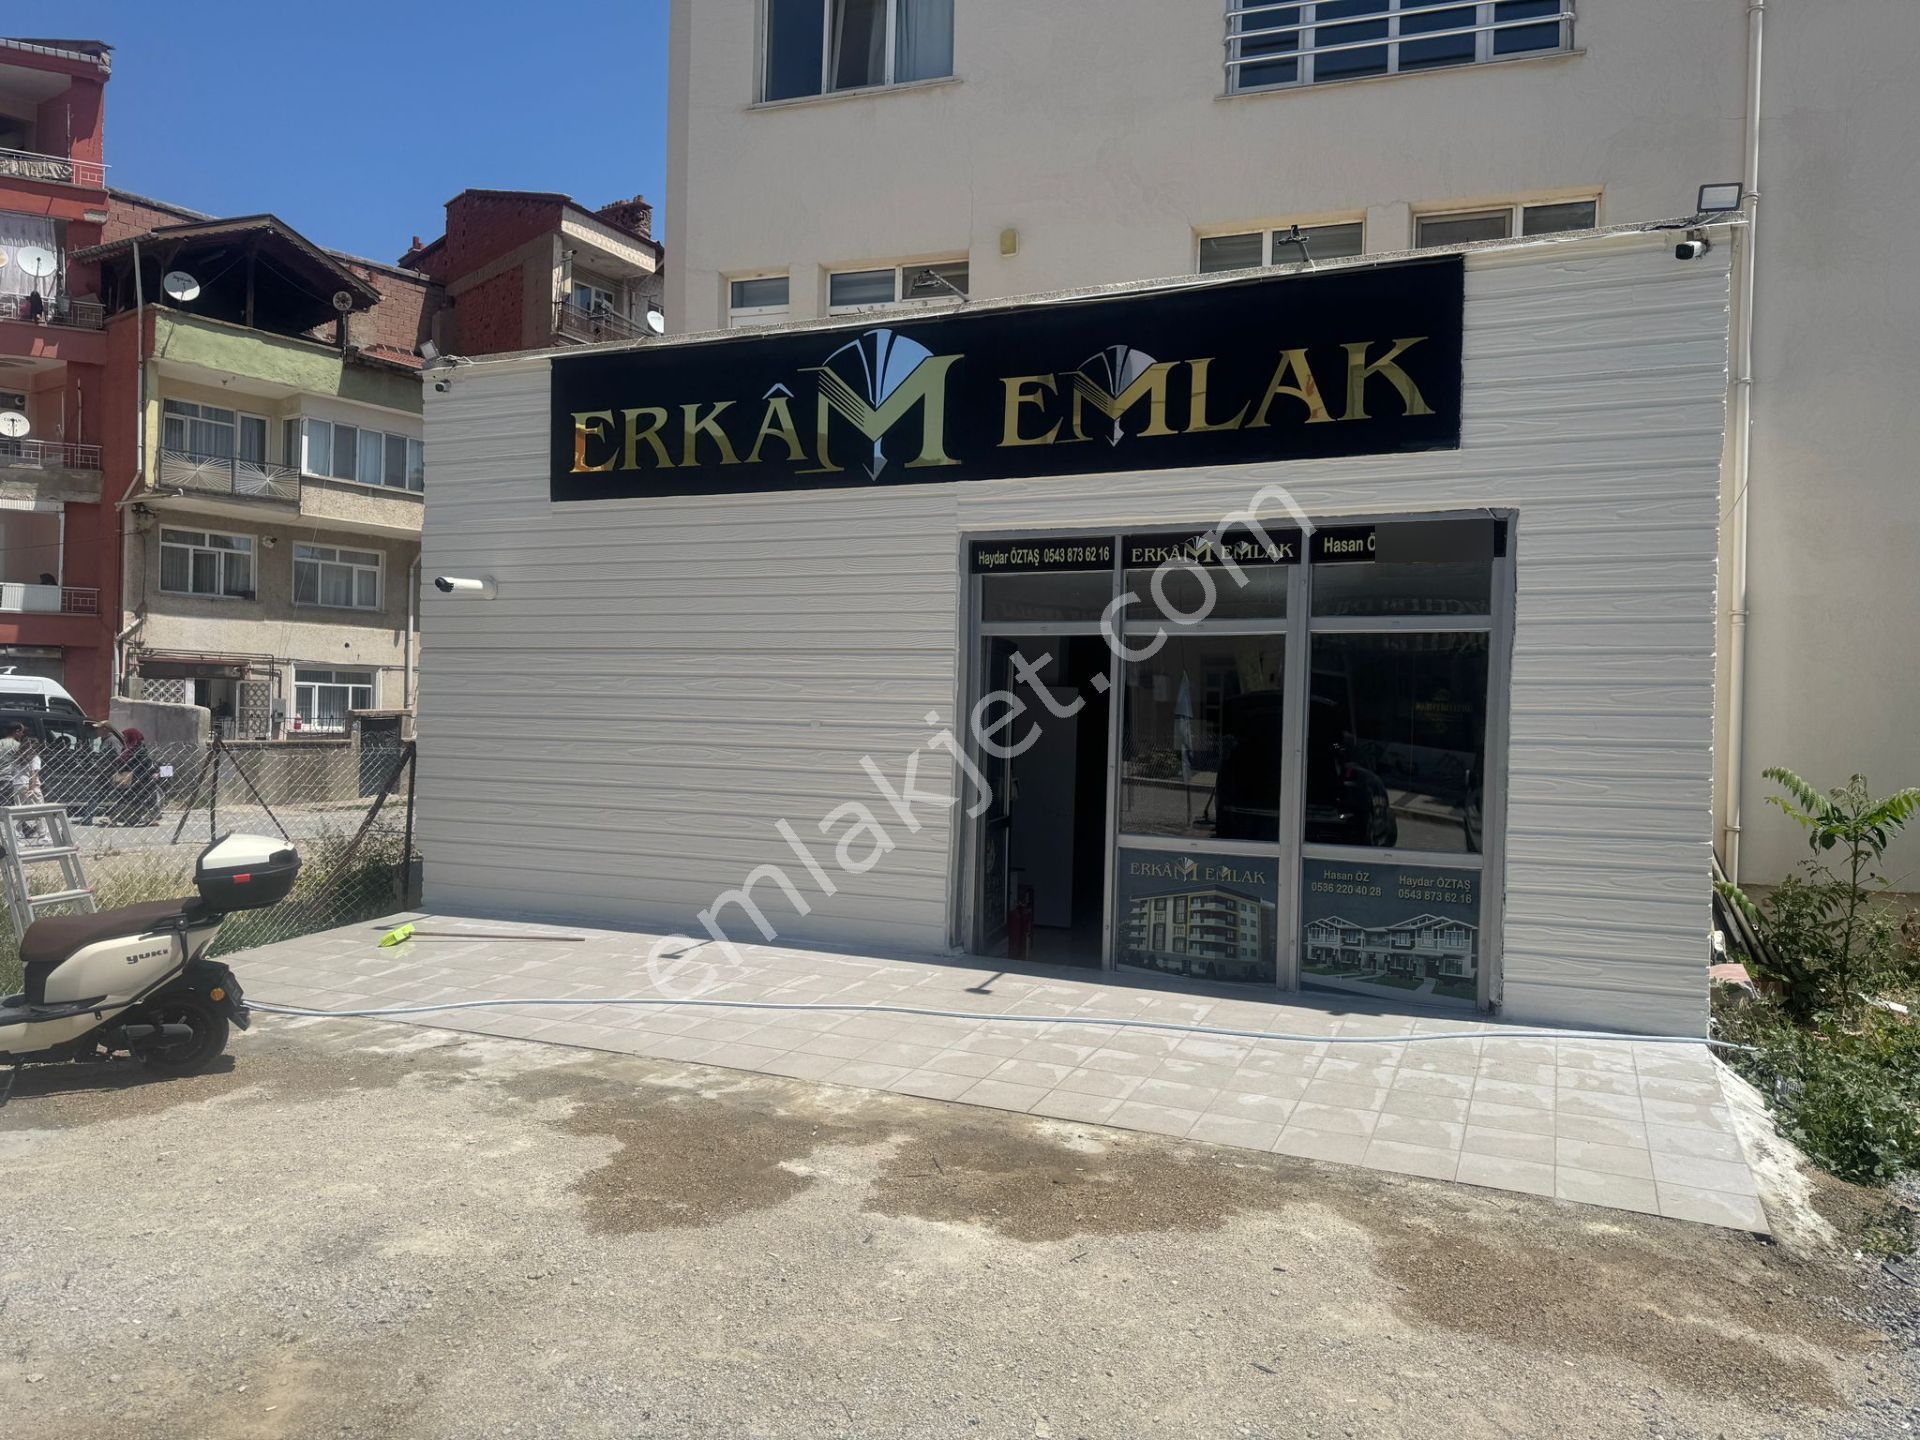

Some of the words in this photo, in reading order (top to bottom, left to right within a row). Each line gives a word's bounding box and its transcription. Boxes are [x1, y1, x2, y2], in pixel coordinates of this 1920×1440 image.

[569, 328, 965, 481] ERKÂM
[996, 337, 1436, 448] EMLAK
[1131, 536, 1216, 563] ERKÂM
[1220, 541, 1295, 560] EMLAK
[1324, 536, 1364, 553] Hasan
[978, 550, 1009, 568] Haydar
[1010, 546, 1040, 566] ÖZTAŞ
[1043, 547, 1066, 563] 0543
[1067, 546, 1084, 562] 873
[1085, 546, 1097, 561] 62
[1098, 546, 1111, 561] 16
[1130, 856, 1200, 882] ERKÂM
[1205, 866, 1266, 885] EMLAK
[1323, 870, 1353, 881] Hasan
[1311, 882, 1334, 893] 0536
[1336, 883, 1354, 895] 220
[1355, 884, 1368, 896] 40
[1369, 886, 1382, 897] 28
[1399, 874, 1435, 888] Haydar
[1398, 888, 1422, 900] 0543
[1424, 890, 1442, 902] 873
[1444, 892, 1457, 903] 62
